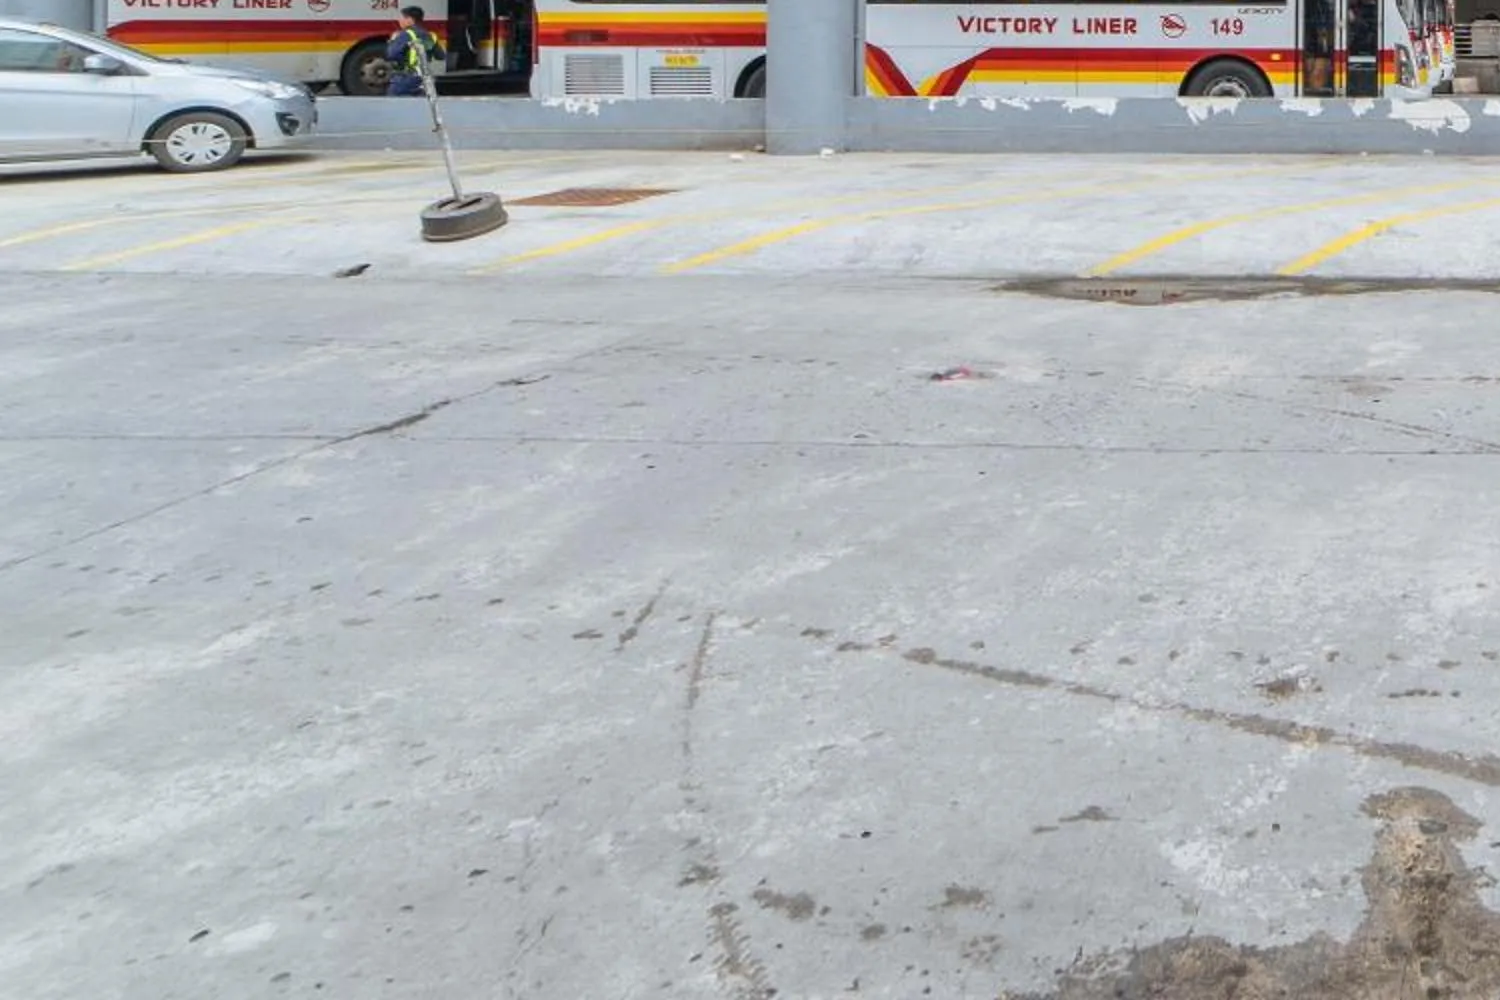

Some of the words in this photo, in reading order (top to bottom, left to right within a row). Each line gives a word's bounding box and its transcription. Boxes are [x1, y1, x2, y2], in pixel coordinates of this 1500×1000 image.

[957, 15, 1058, 34] VICTORY
[1072, 17, 1137, 35] LINER
[1211, 17, 1244, 35] 149
